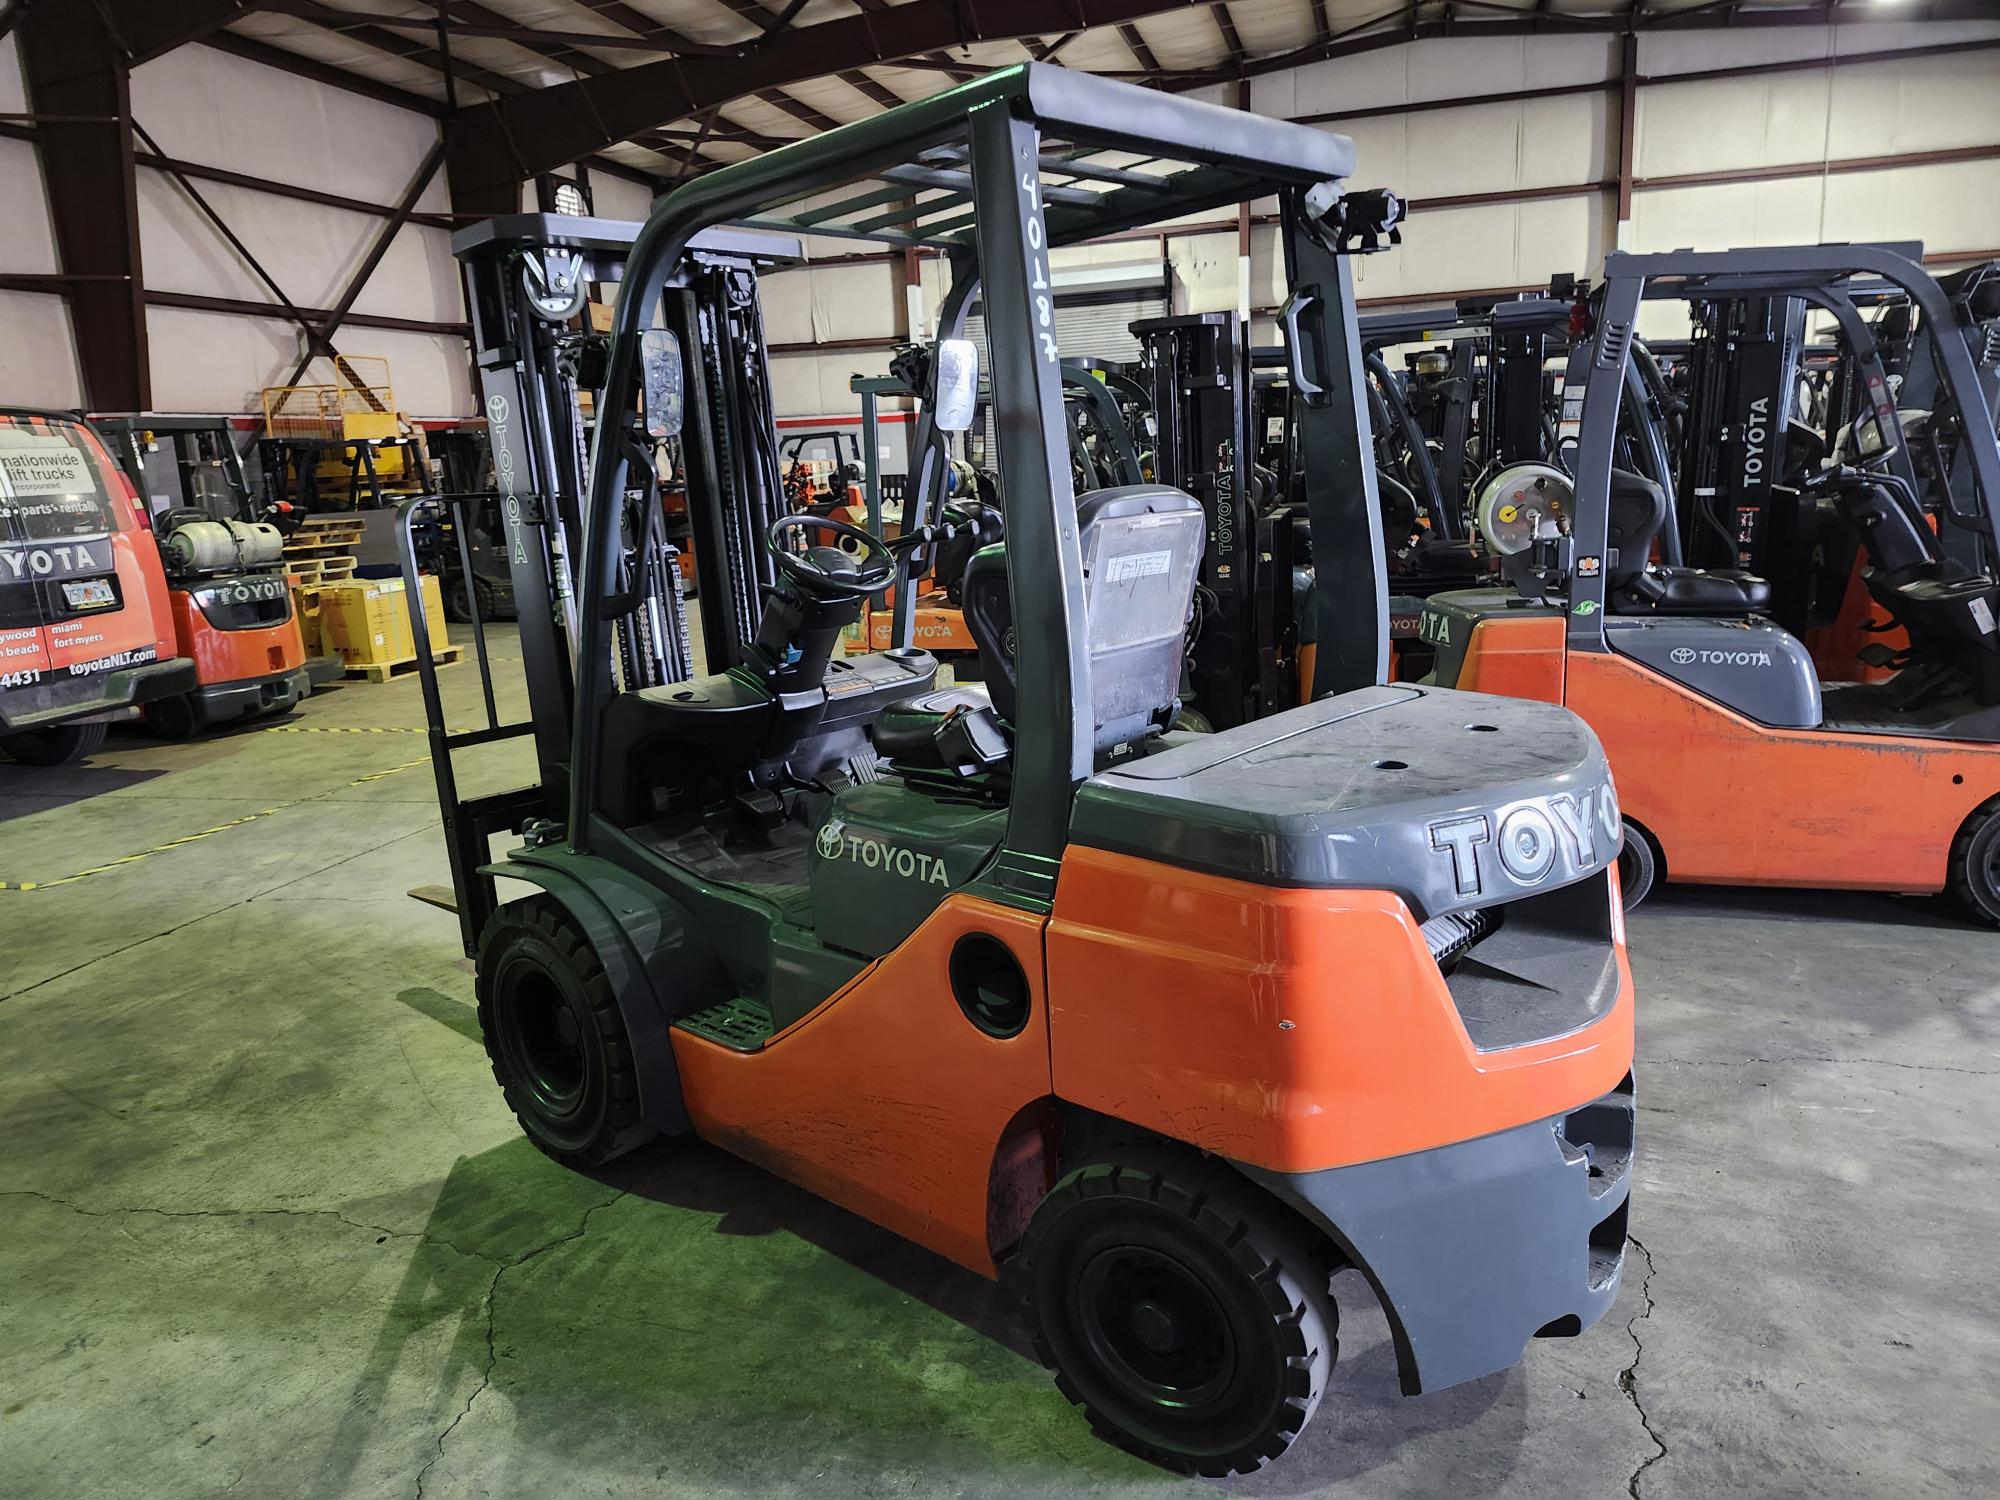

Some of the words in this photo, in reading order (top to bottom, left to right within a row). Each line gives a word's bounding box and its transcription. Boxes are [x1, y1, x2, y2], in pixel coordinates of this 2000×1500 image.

[1744, 397, 1768, 487] TOYOTA
[1, 453, 79, 467] nationwide
[7, 468, 29, 481] lift
[31, 465, 75, 480] trucks
[495, 425, 528, 564] TOYOTA
[1217, 475, 1232, 555] TOYOTA
[0, 545, 96, 577] YOTA
[217, 581, 287, 604] TOYOTA
[52, 621, 82, 634] miami
[6, 643, 40, 657] beach
[54, 638, 73, 648] fort
[75, 633, 103, 645] myers
[69, 649, 156, 676] toyotaNLT.com
[1699, 650, 1771, 667] TOYOTA
[0, 668, 40, 688] 4431
[1427, 784, 1620, 900] TOYO
[848, 835, 950, 888] TOYOTA
